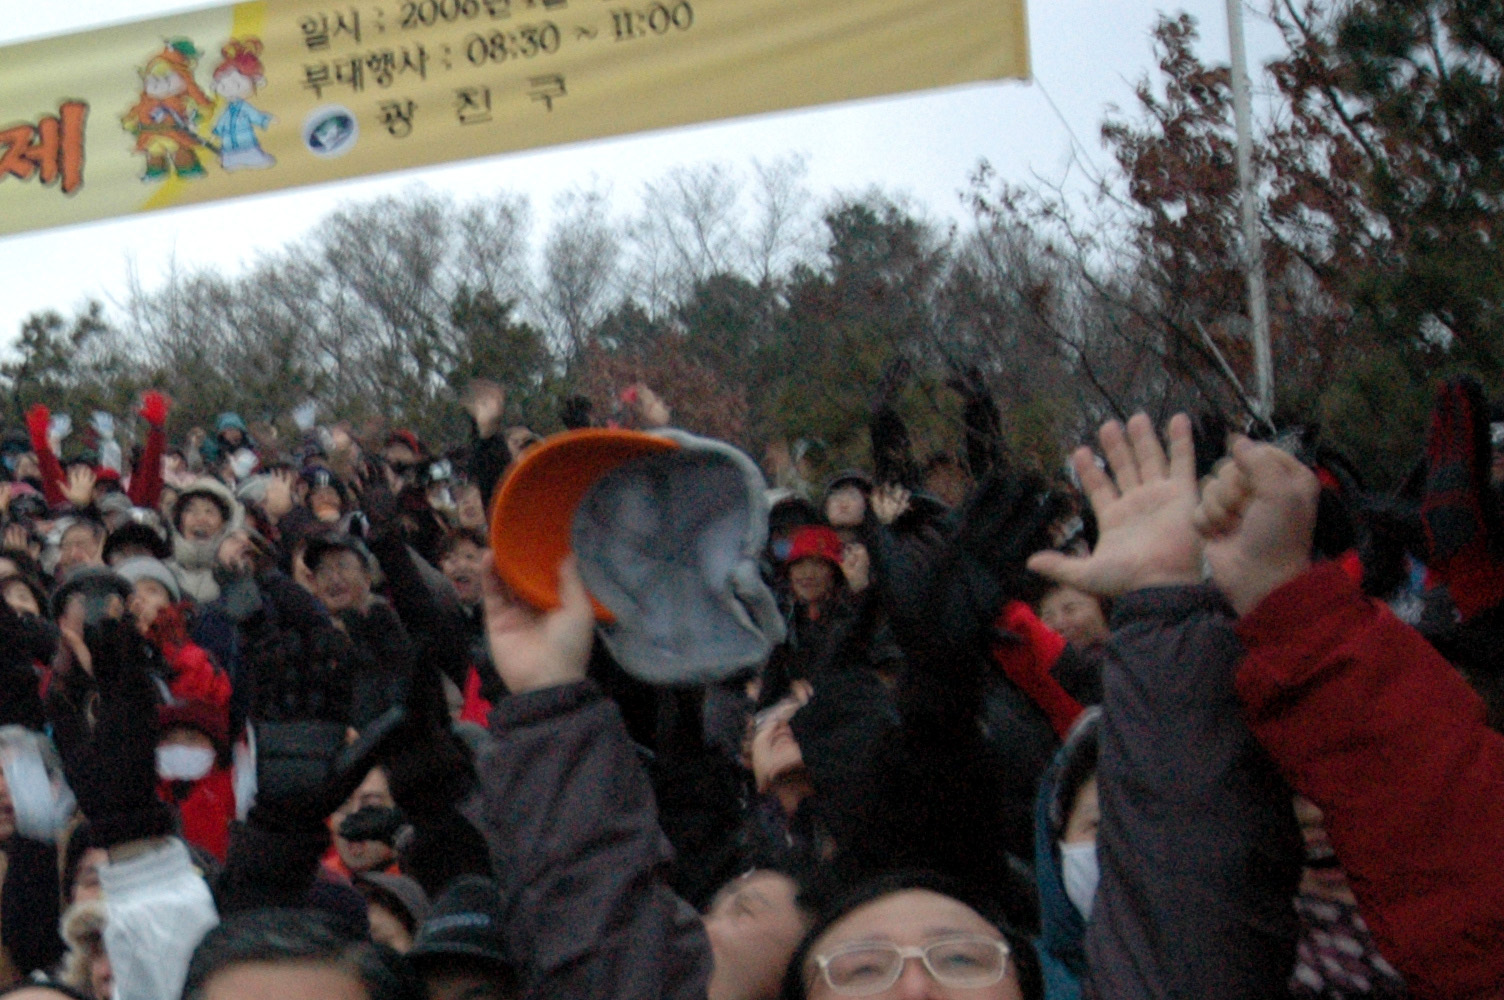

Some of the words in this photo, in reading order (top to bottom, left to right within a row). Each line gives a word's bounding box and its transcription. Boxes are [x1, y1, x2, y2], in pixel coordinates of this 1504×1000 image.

[300, 10, 361, 50] 일시
[300, 45, 429, 99] 부대행사
[467, 21, 560, 67] 08:30
[612, 0, 693, 41] 11:00
[378, 99, 417, 138] 광
[456, 86, 493, 125] 진
[528, 72, 567, 112] 구
